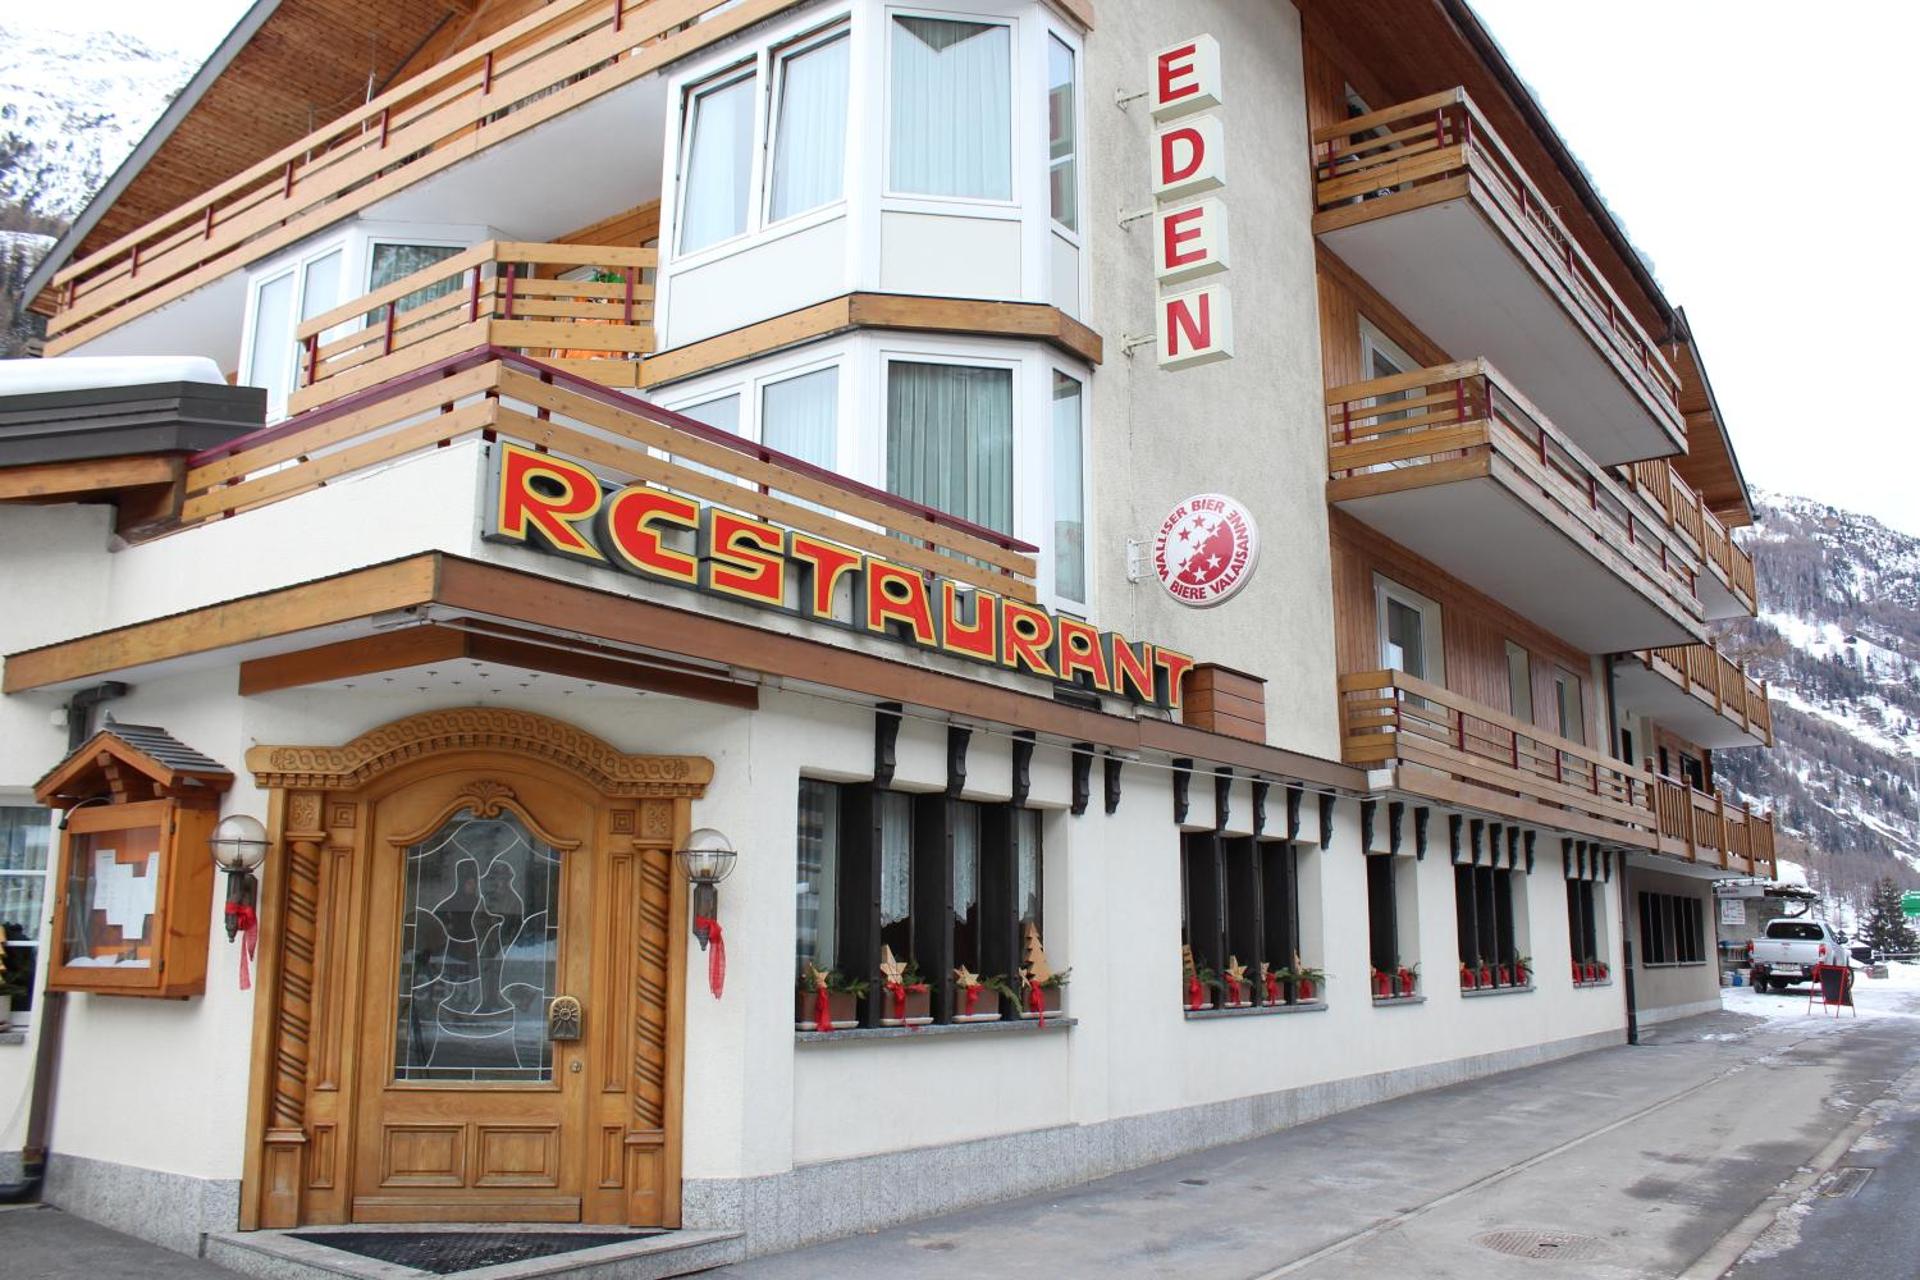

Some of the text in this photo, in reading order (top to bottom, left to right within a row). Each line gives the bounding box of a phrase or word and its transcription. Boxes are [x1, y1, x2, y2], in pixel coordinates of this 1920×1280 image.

[1158, 43, 1211, 357] EDEN
[494, 441, 1194, 708] RESTAURANT
[1155, 499, 1225, 581] WALLISER BIER
[1169, 510, 1249, 600] BIERE VALAISANNE
